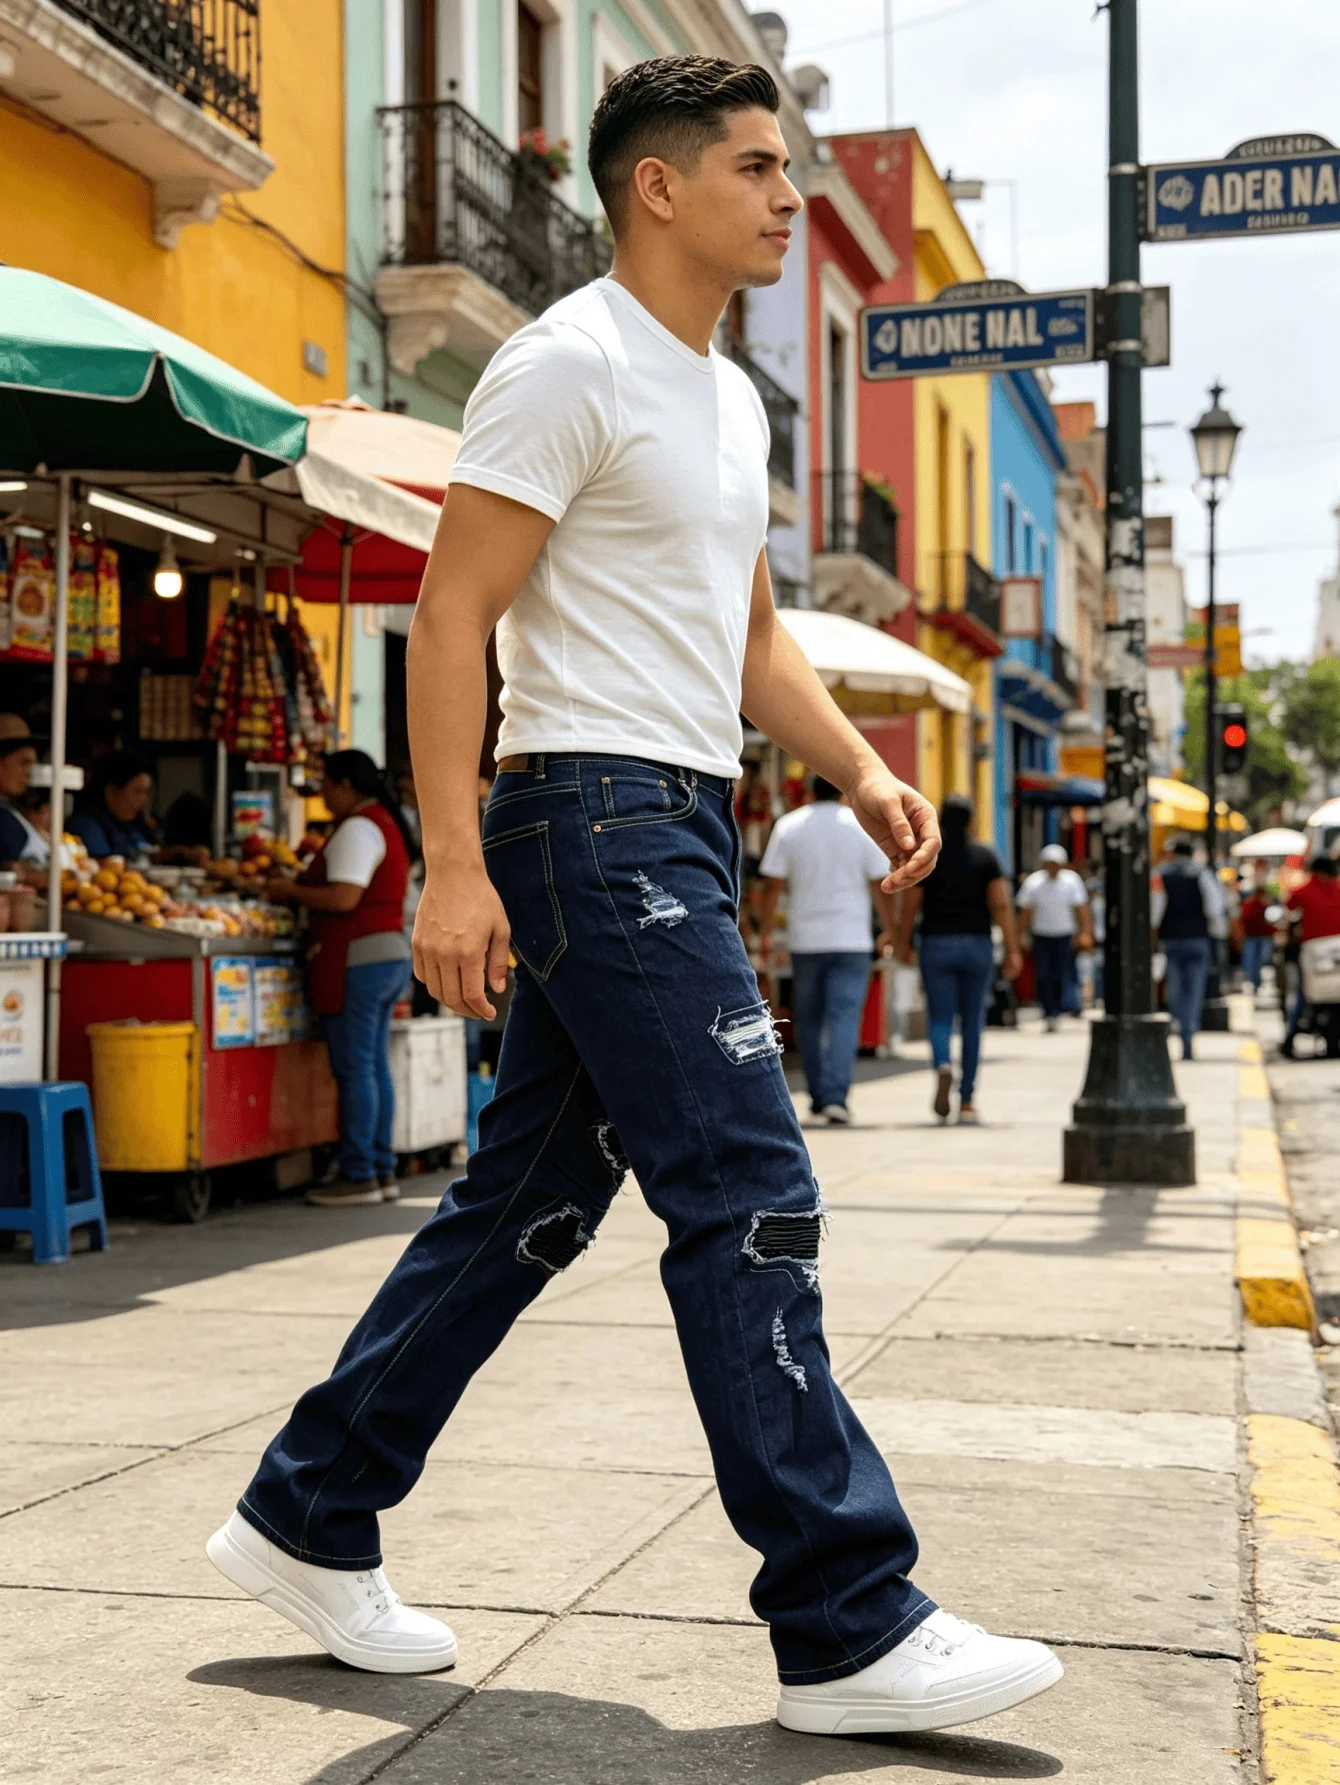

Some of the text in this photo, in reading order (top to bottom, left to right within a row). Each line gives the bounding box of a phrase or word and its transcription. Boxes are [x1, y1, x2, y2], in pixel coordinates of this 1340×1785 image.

[1200, 164, 1340, 216] ADER NA
[985, 306, 1044, 349] NAL
